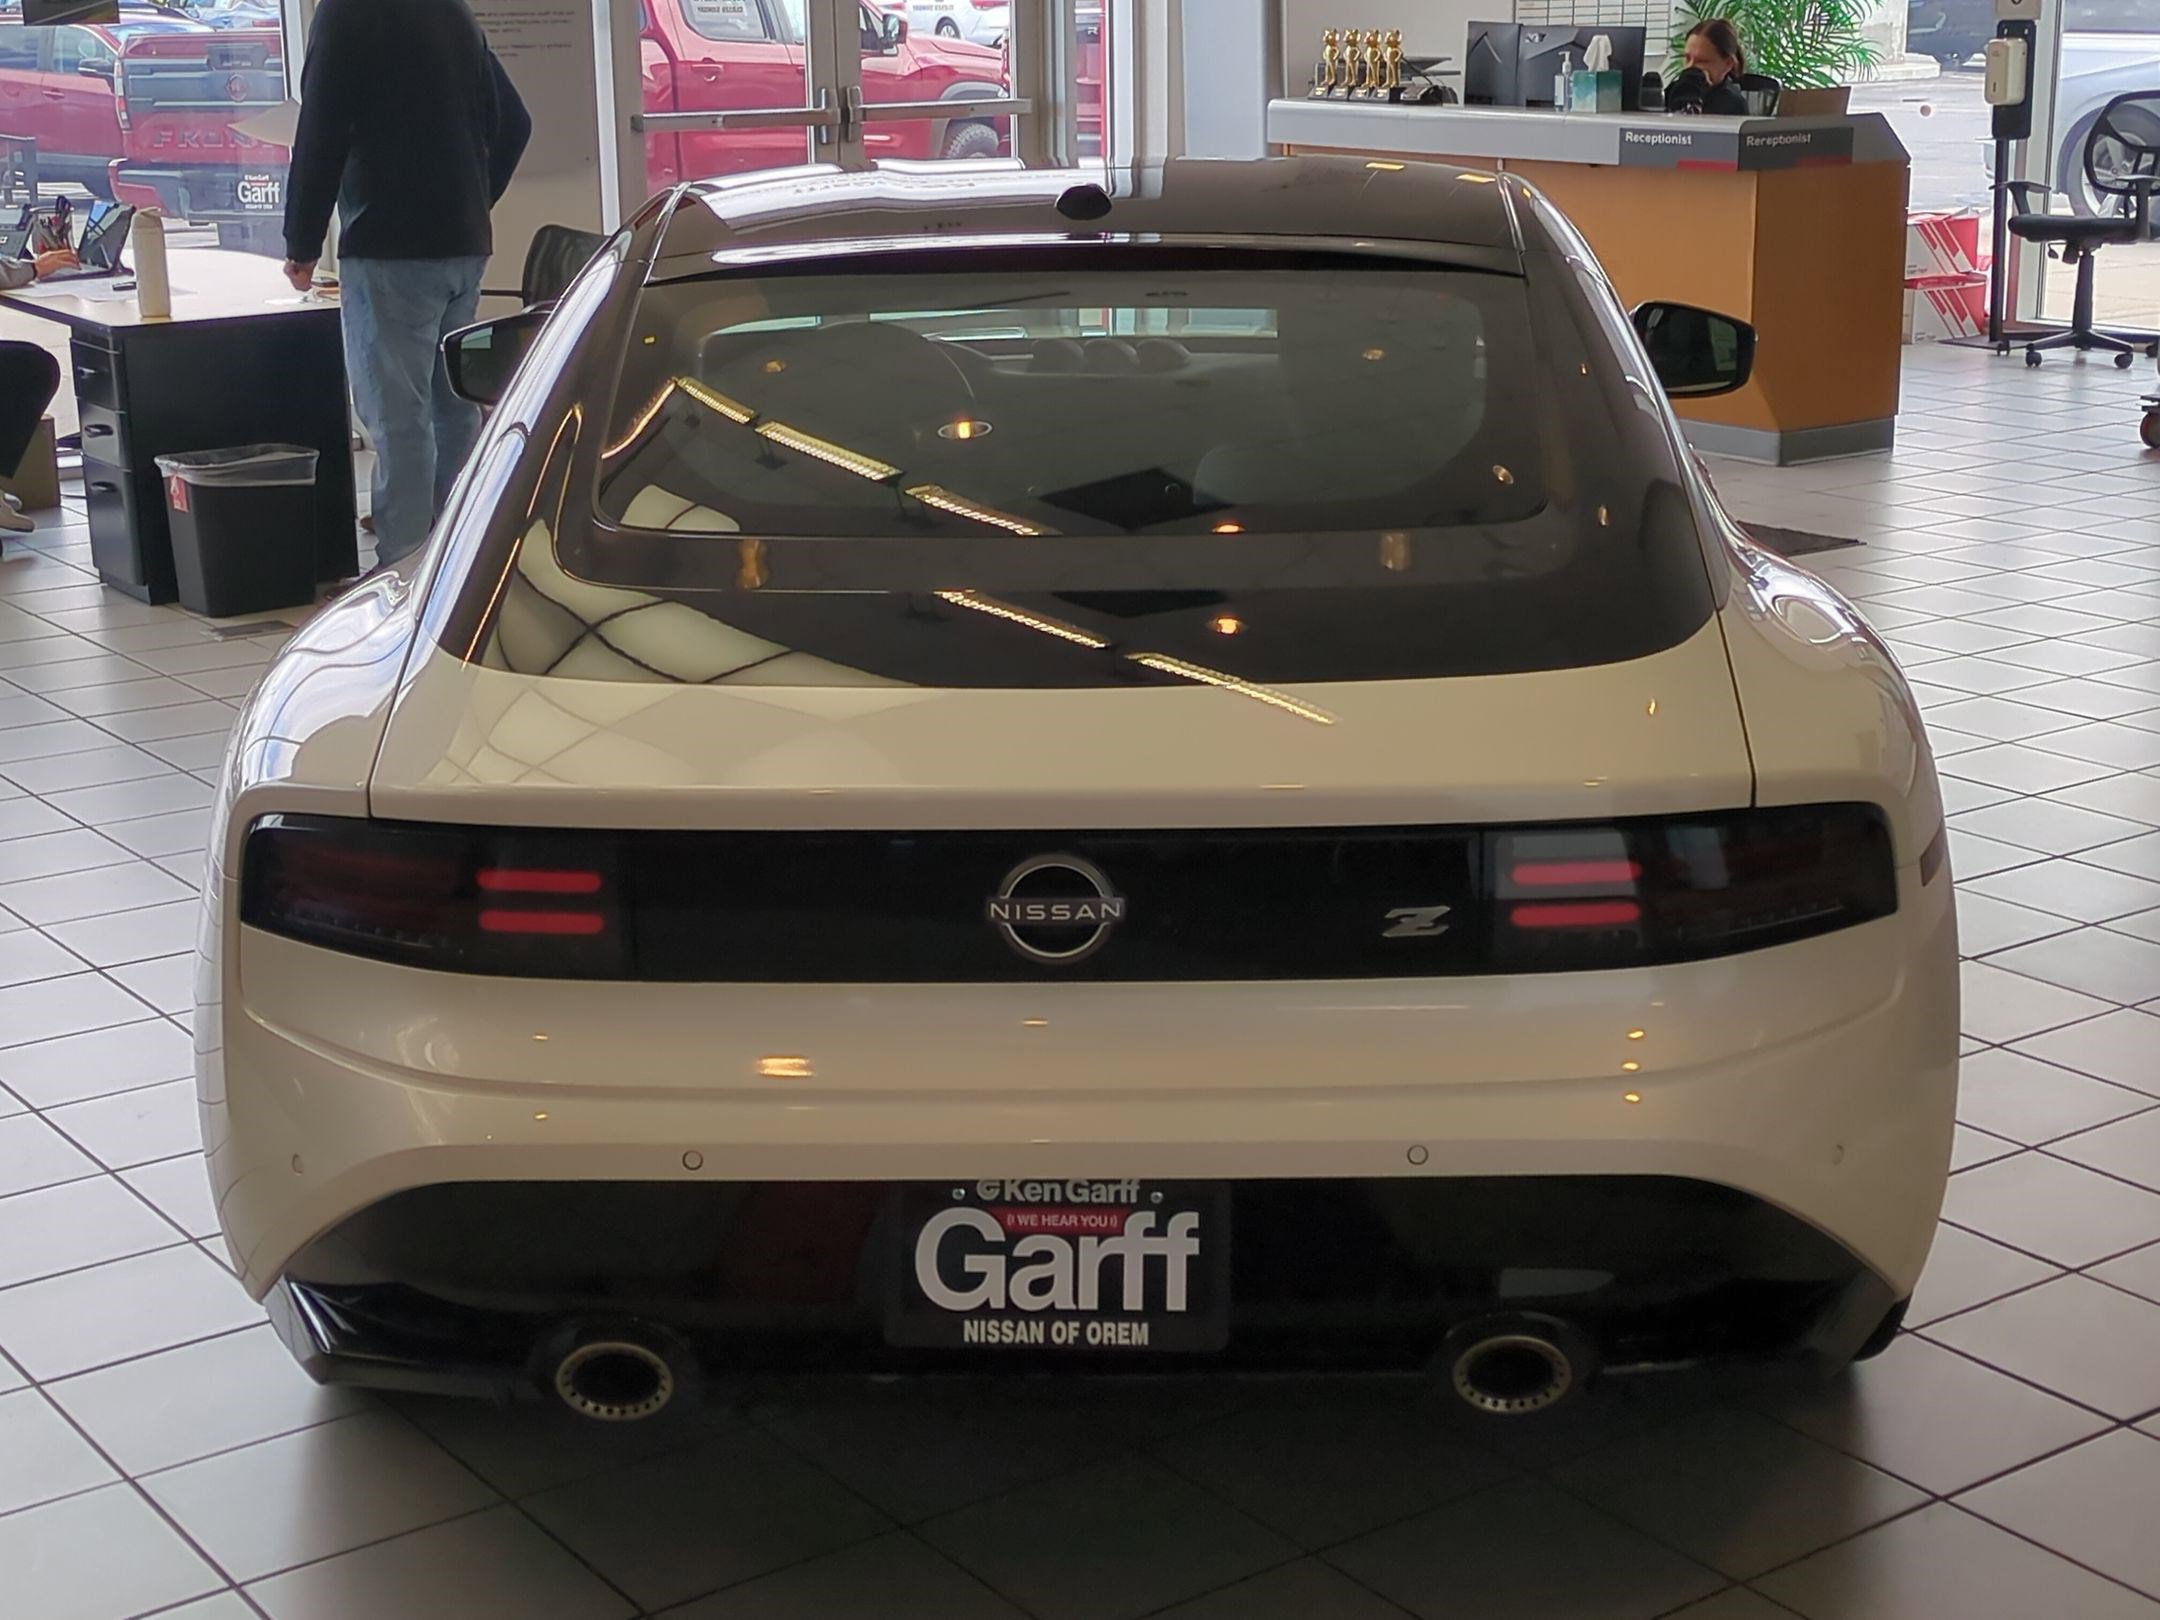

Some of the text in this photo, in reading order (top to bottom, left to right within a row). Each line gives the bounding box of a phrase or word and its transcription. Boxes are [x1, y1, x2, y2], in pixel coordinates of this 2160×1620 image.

[1625, 131, 1692, 146] Receptionist
[237, 181, 280, 203] Garff
[990, 902, 1121, 921] NISSAN
[1382, 905, 1451, 937] Z
[1004, 1179, 1140, 1204] Ken Garff
[1017, 1214, 1108, 1228] WE HEAR YOU
[915, 1206, 1200, 1312] Garff
[963, 1320, 1149, 1346] NISSAN OF OREM
